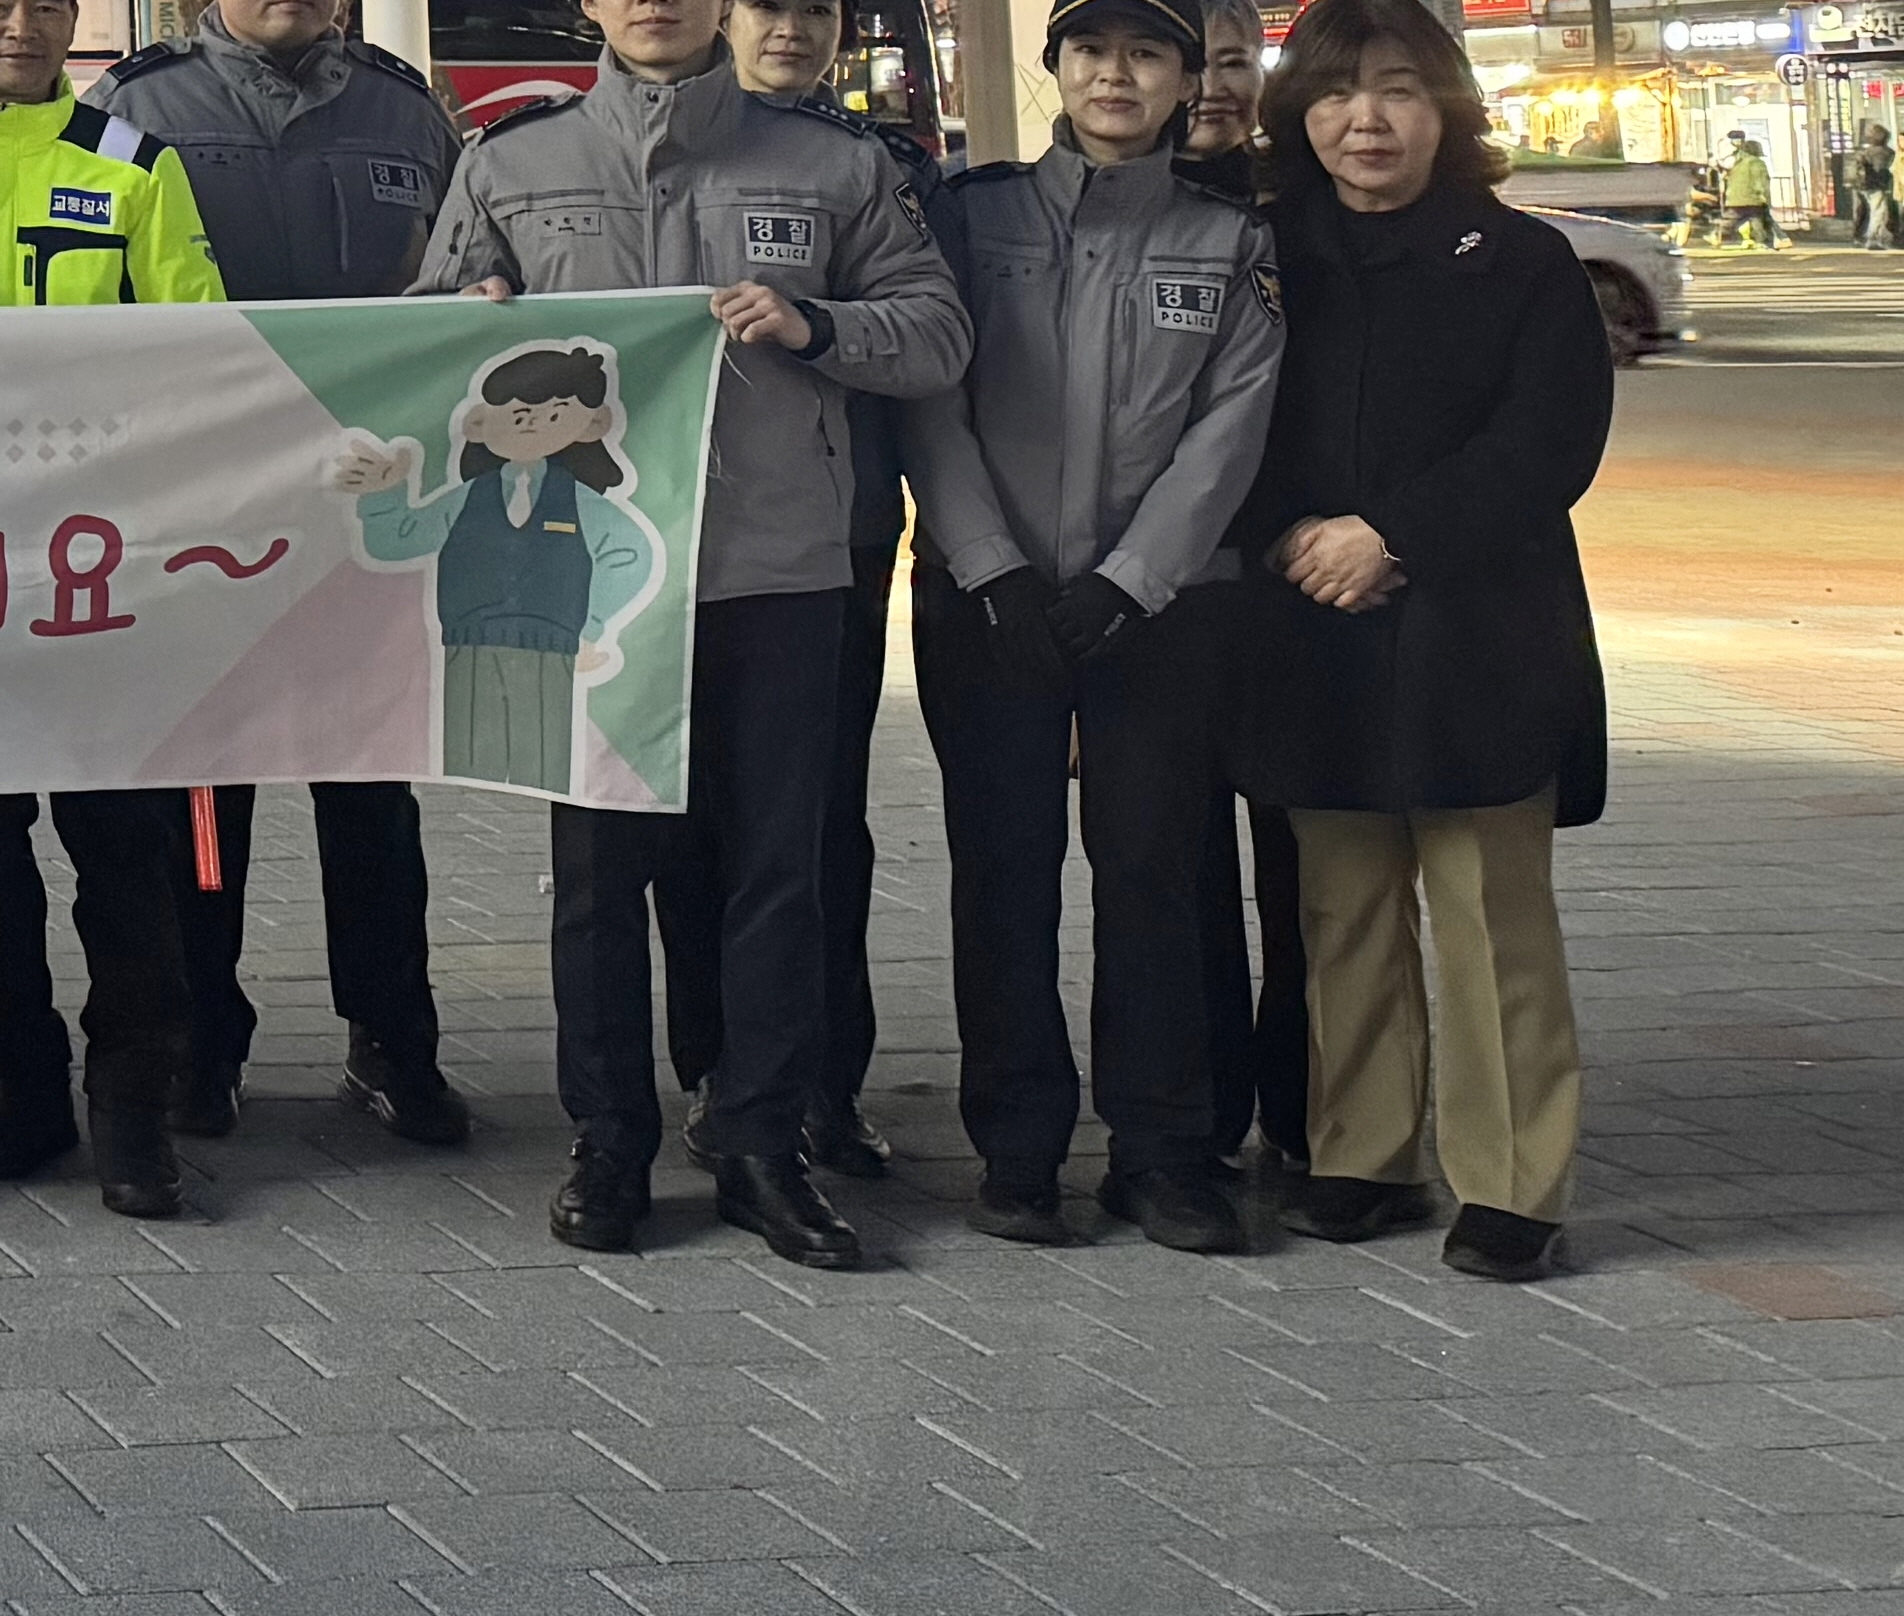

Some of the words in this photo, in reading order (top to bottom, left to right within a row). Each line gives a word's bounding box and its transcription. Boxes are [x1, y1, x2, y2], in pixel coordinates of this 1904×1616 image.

[51, 192, 112, 220] 교통질서
[753, 217, 810, 245] 경찰
[752, 245, 809, 262] POLICE
